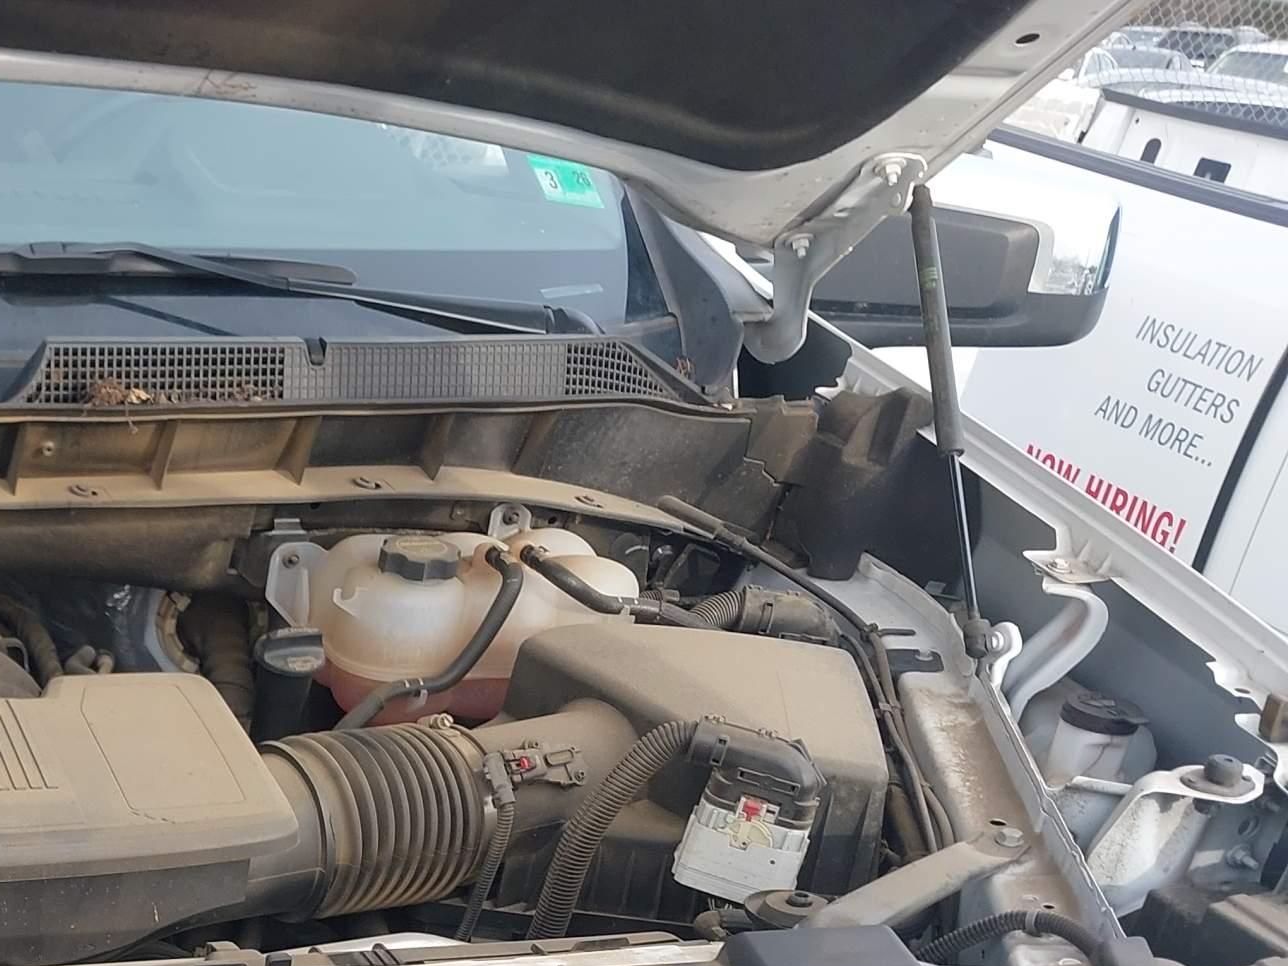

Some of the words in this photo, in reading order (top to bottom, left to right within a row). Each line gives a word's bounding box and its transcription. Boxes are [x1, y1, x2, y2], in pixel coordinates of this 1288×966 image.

[544, 170, 558, 189] 3
[1135, 315, 1264, 383] INSULATION
[1146, 368, 1240, 424] GUTTERS
[1094, 395, 1138, 429] AND
[1138, 413, 1212, 467] MORE...
